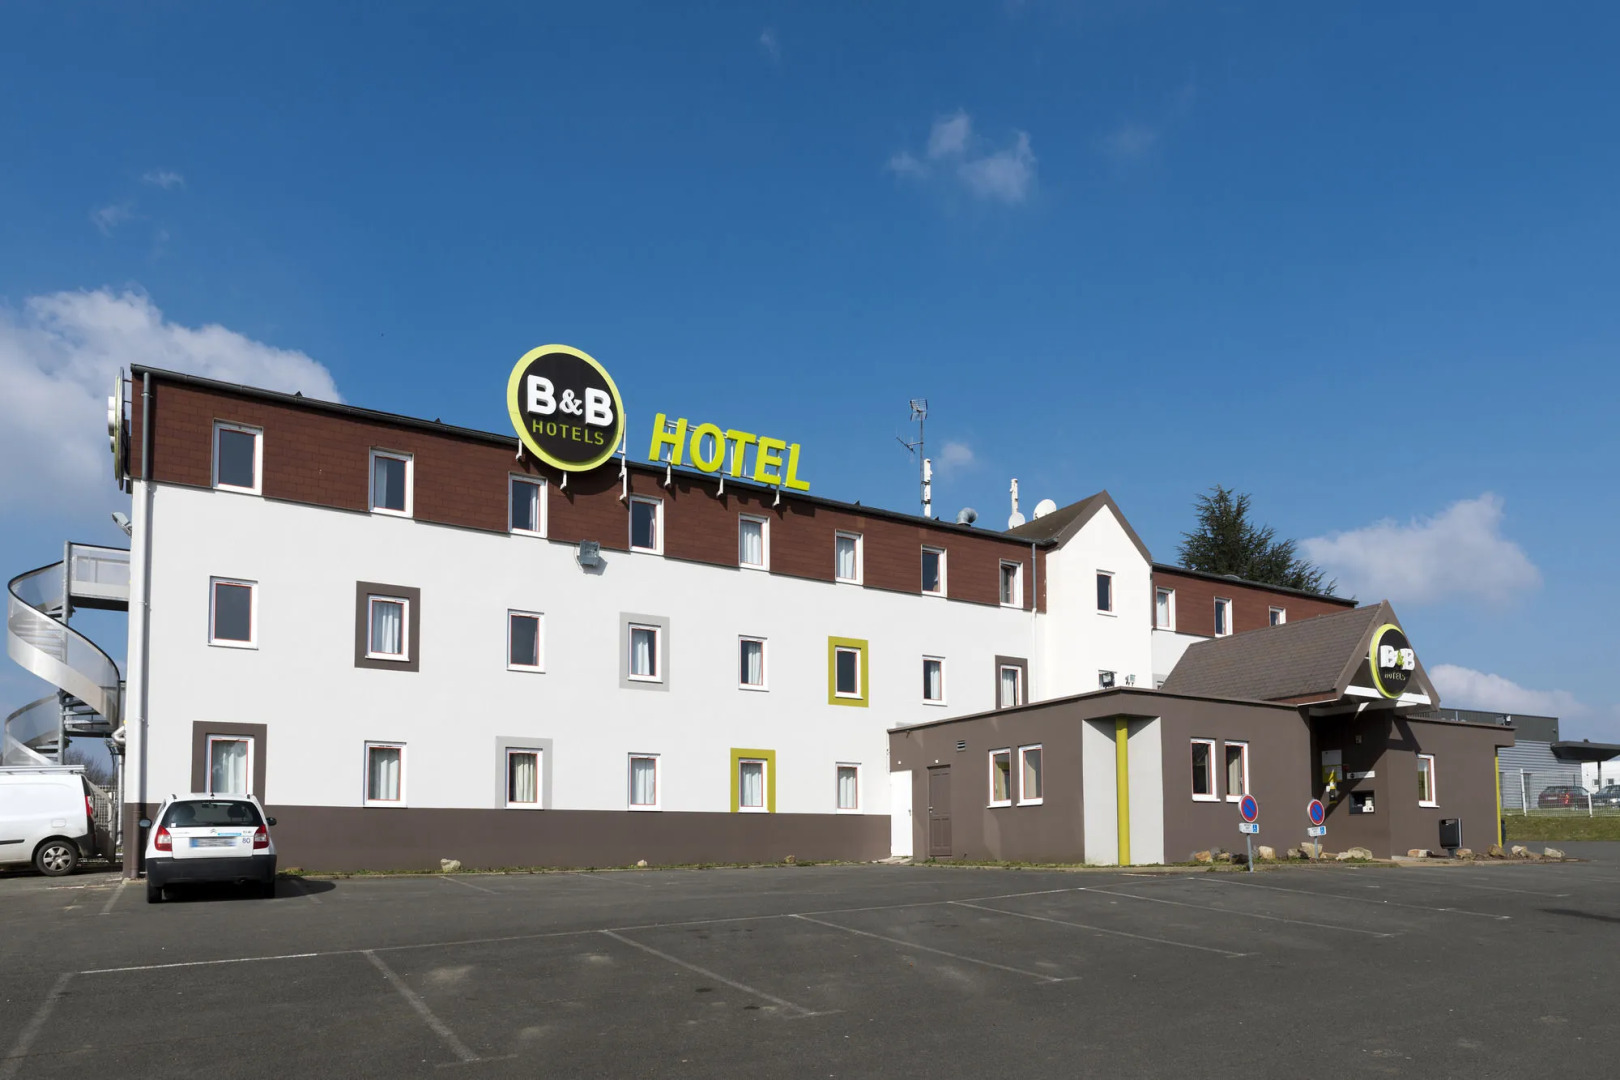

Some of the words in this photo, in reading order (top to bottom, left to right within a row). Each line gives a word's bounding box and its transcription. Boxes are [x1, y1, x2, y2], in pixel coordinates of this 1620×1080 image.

[527, 374, 614, 427] B&B
[532, 419, 605, 446] HOTELS
[648, 413, 811, 491] HOTEL
[1380, 645, 1415, 670] B&B
